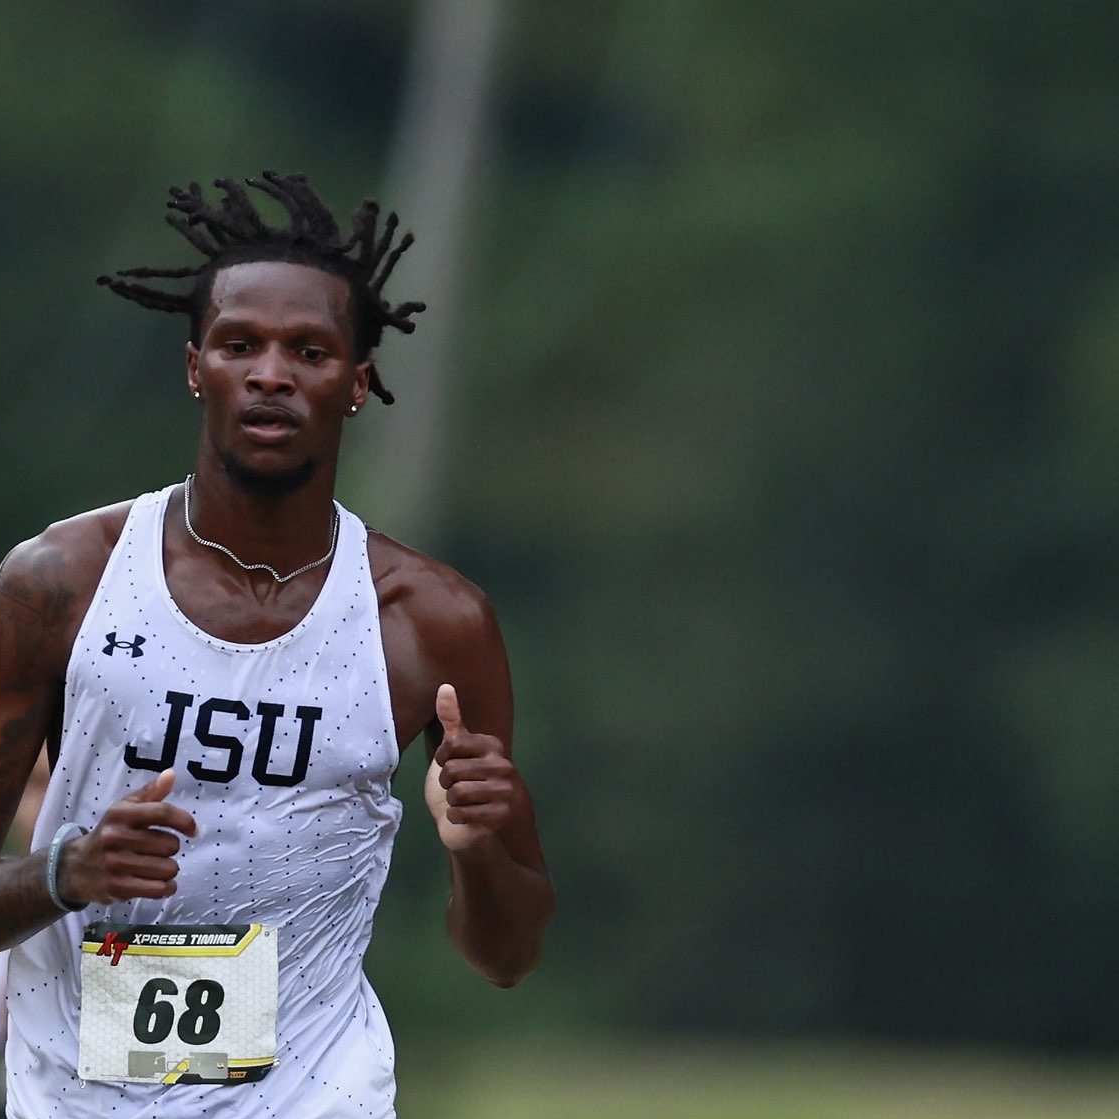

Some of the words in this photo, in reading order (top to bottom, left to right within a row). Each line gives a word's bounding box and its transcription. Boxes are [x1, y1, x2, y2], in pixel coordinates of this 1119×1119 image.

[124, 691, 322, 787] JSU
[96, 932, 128, 966] XT
[132, 933, 187, 945] XPRESS
[190, 933, 237, 945] TIMING
[133, 977, 225, 1046] 68
